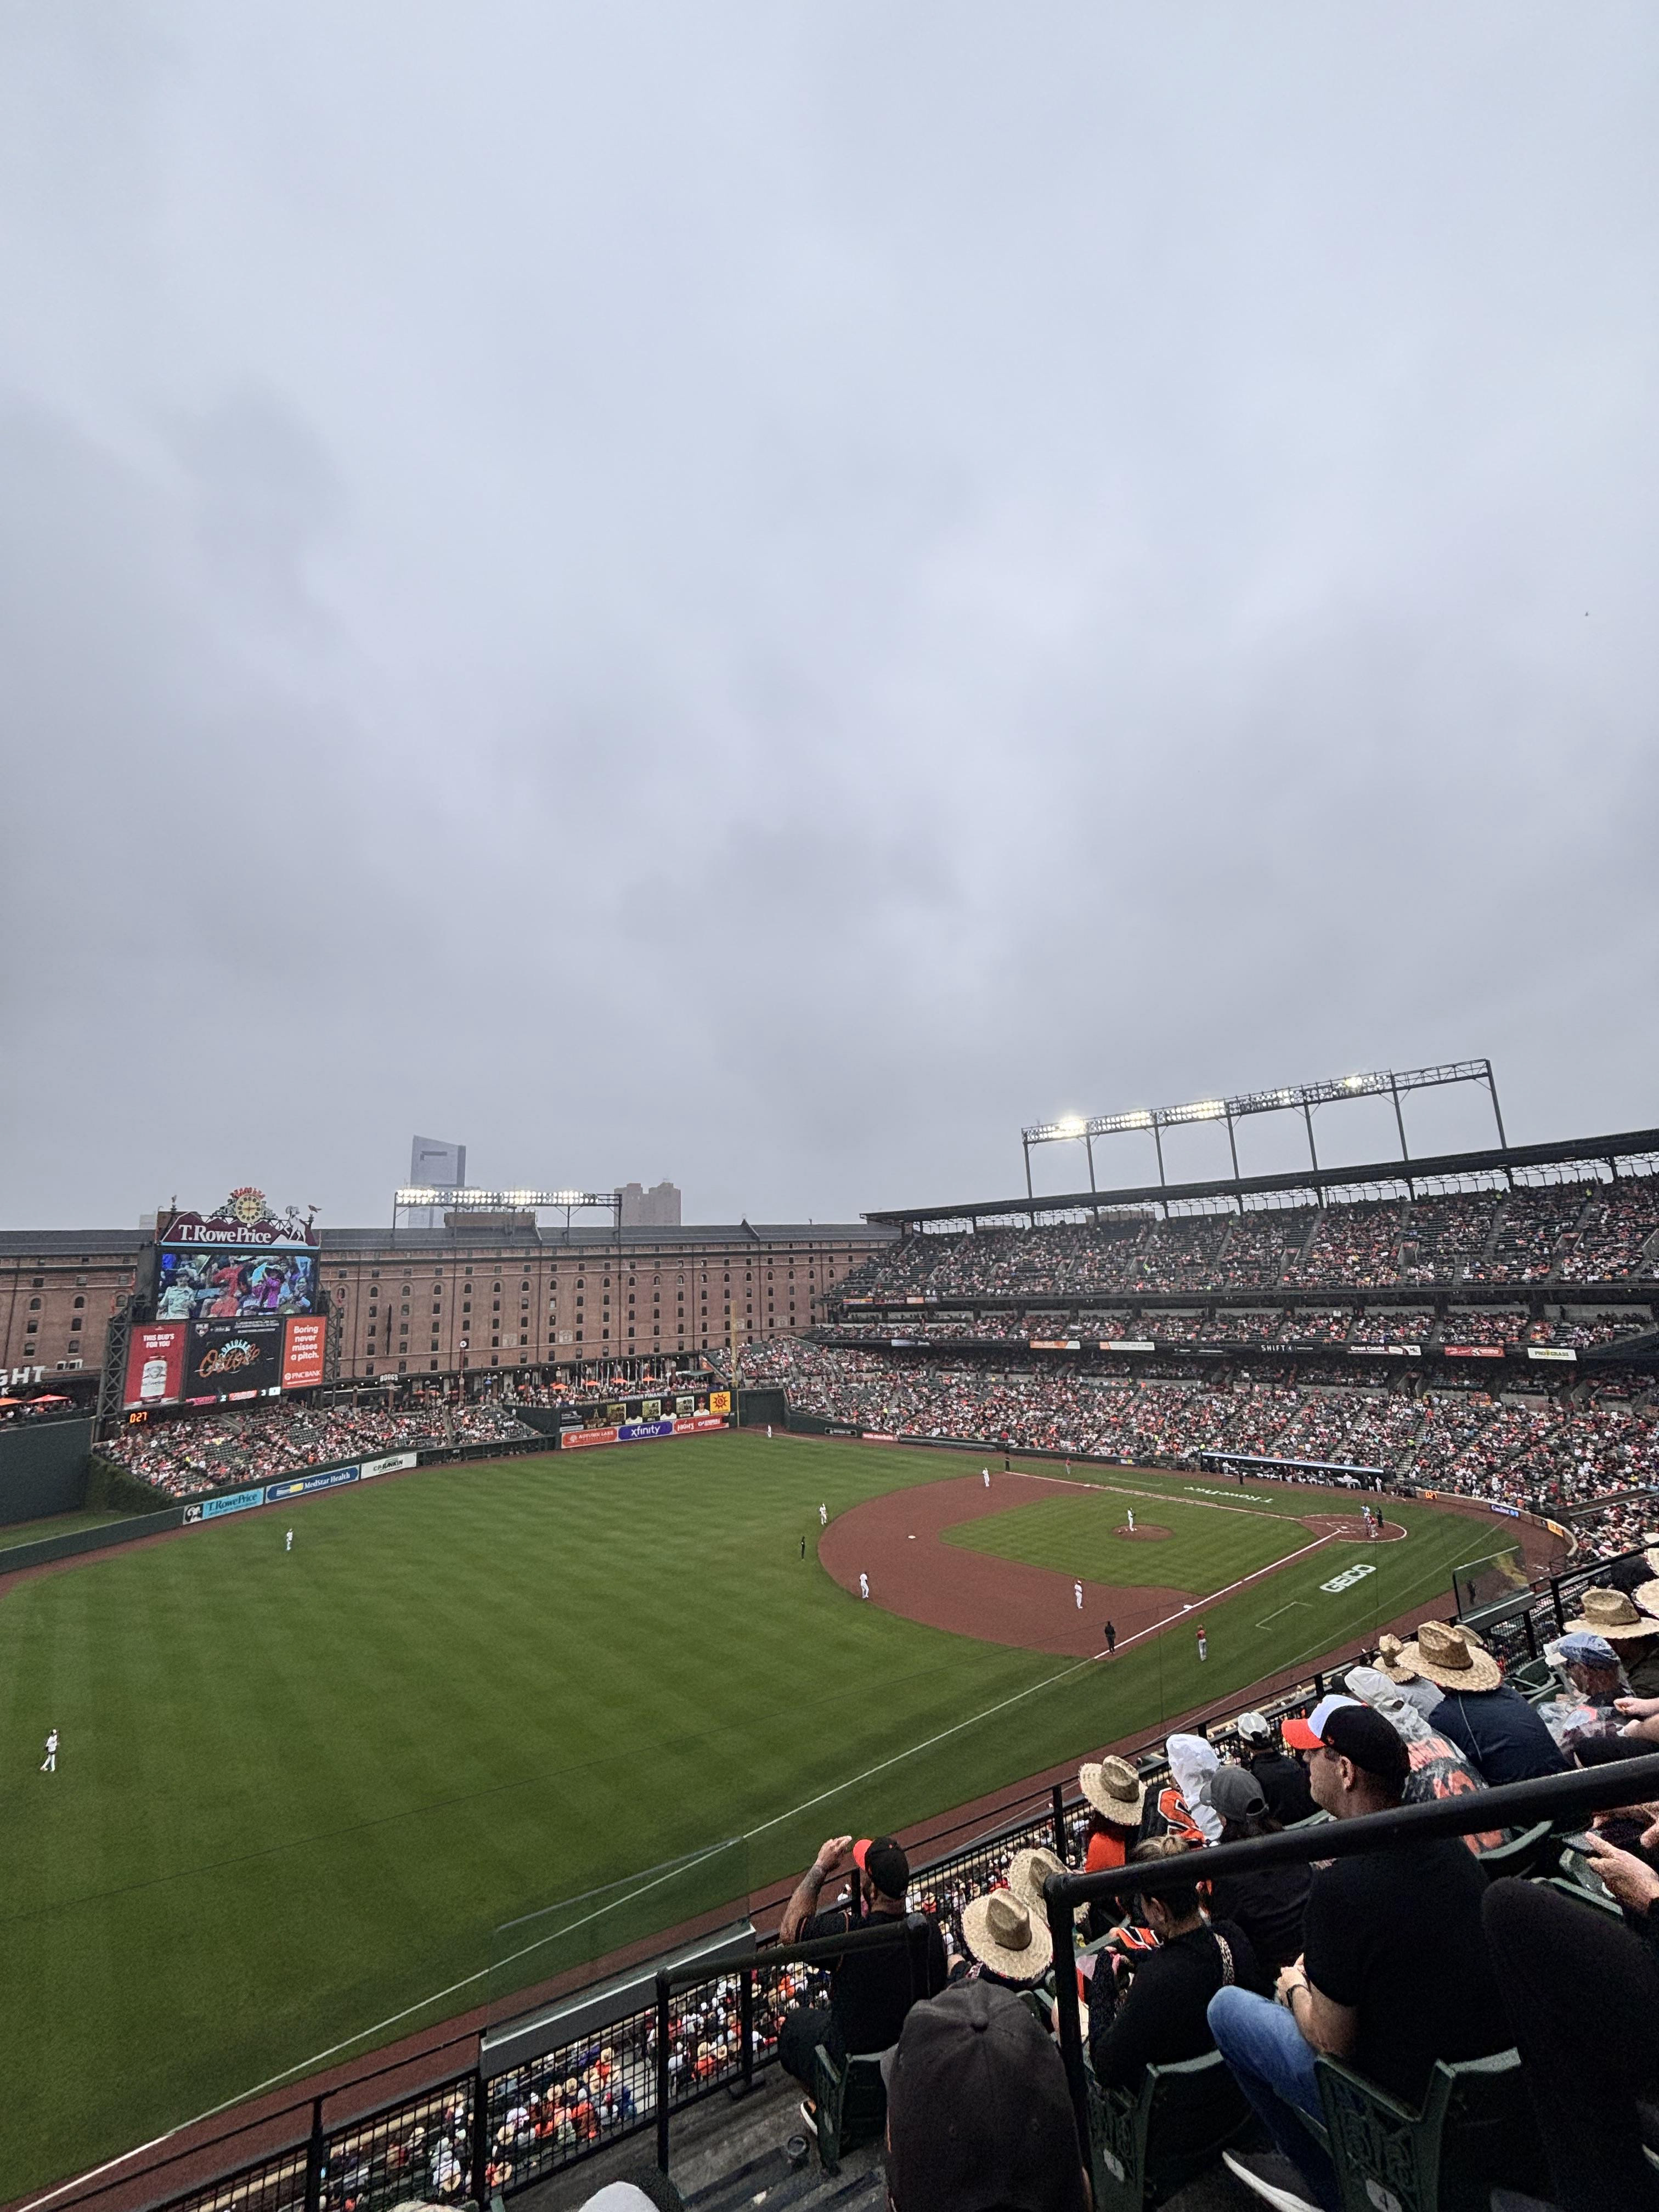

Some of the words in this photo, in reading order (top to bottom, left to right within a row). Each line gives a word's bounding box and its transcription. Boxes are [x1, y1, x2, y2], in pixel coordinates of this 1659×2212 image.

[294, 1325, 319, 1334] Boring
[292, 1342, 318, 1351] misses
[297, 1351, 319, 1362] pitch.
[631, 1425, 661, 1437] xfinity
[304, 1478, 329, 1489] MedStar
[330, 1472, 351, 1483] Health
[1319, 1564, 1377, 1593] GEICO
